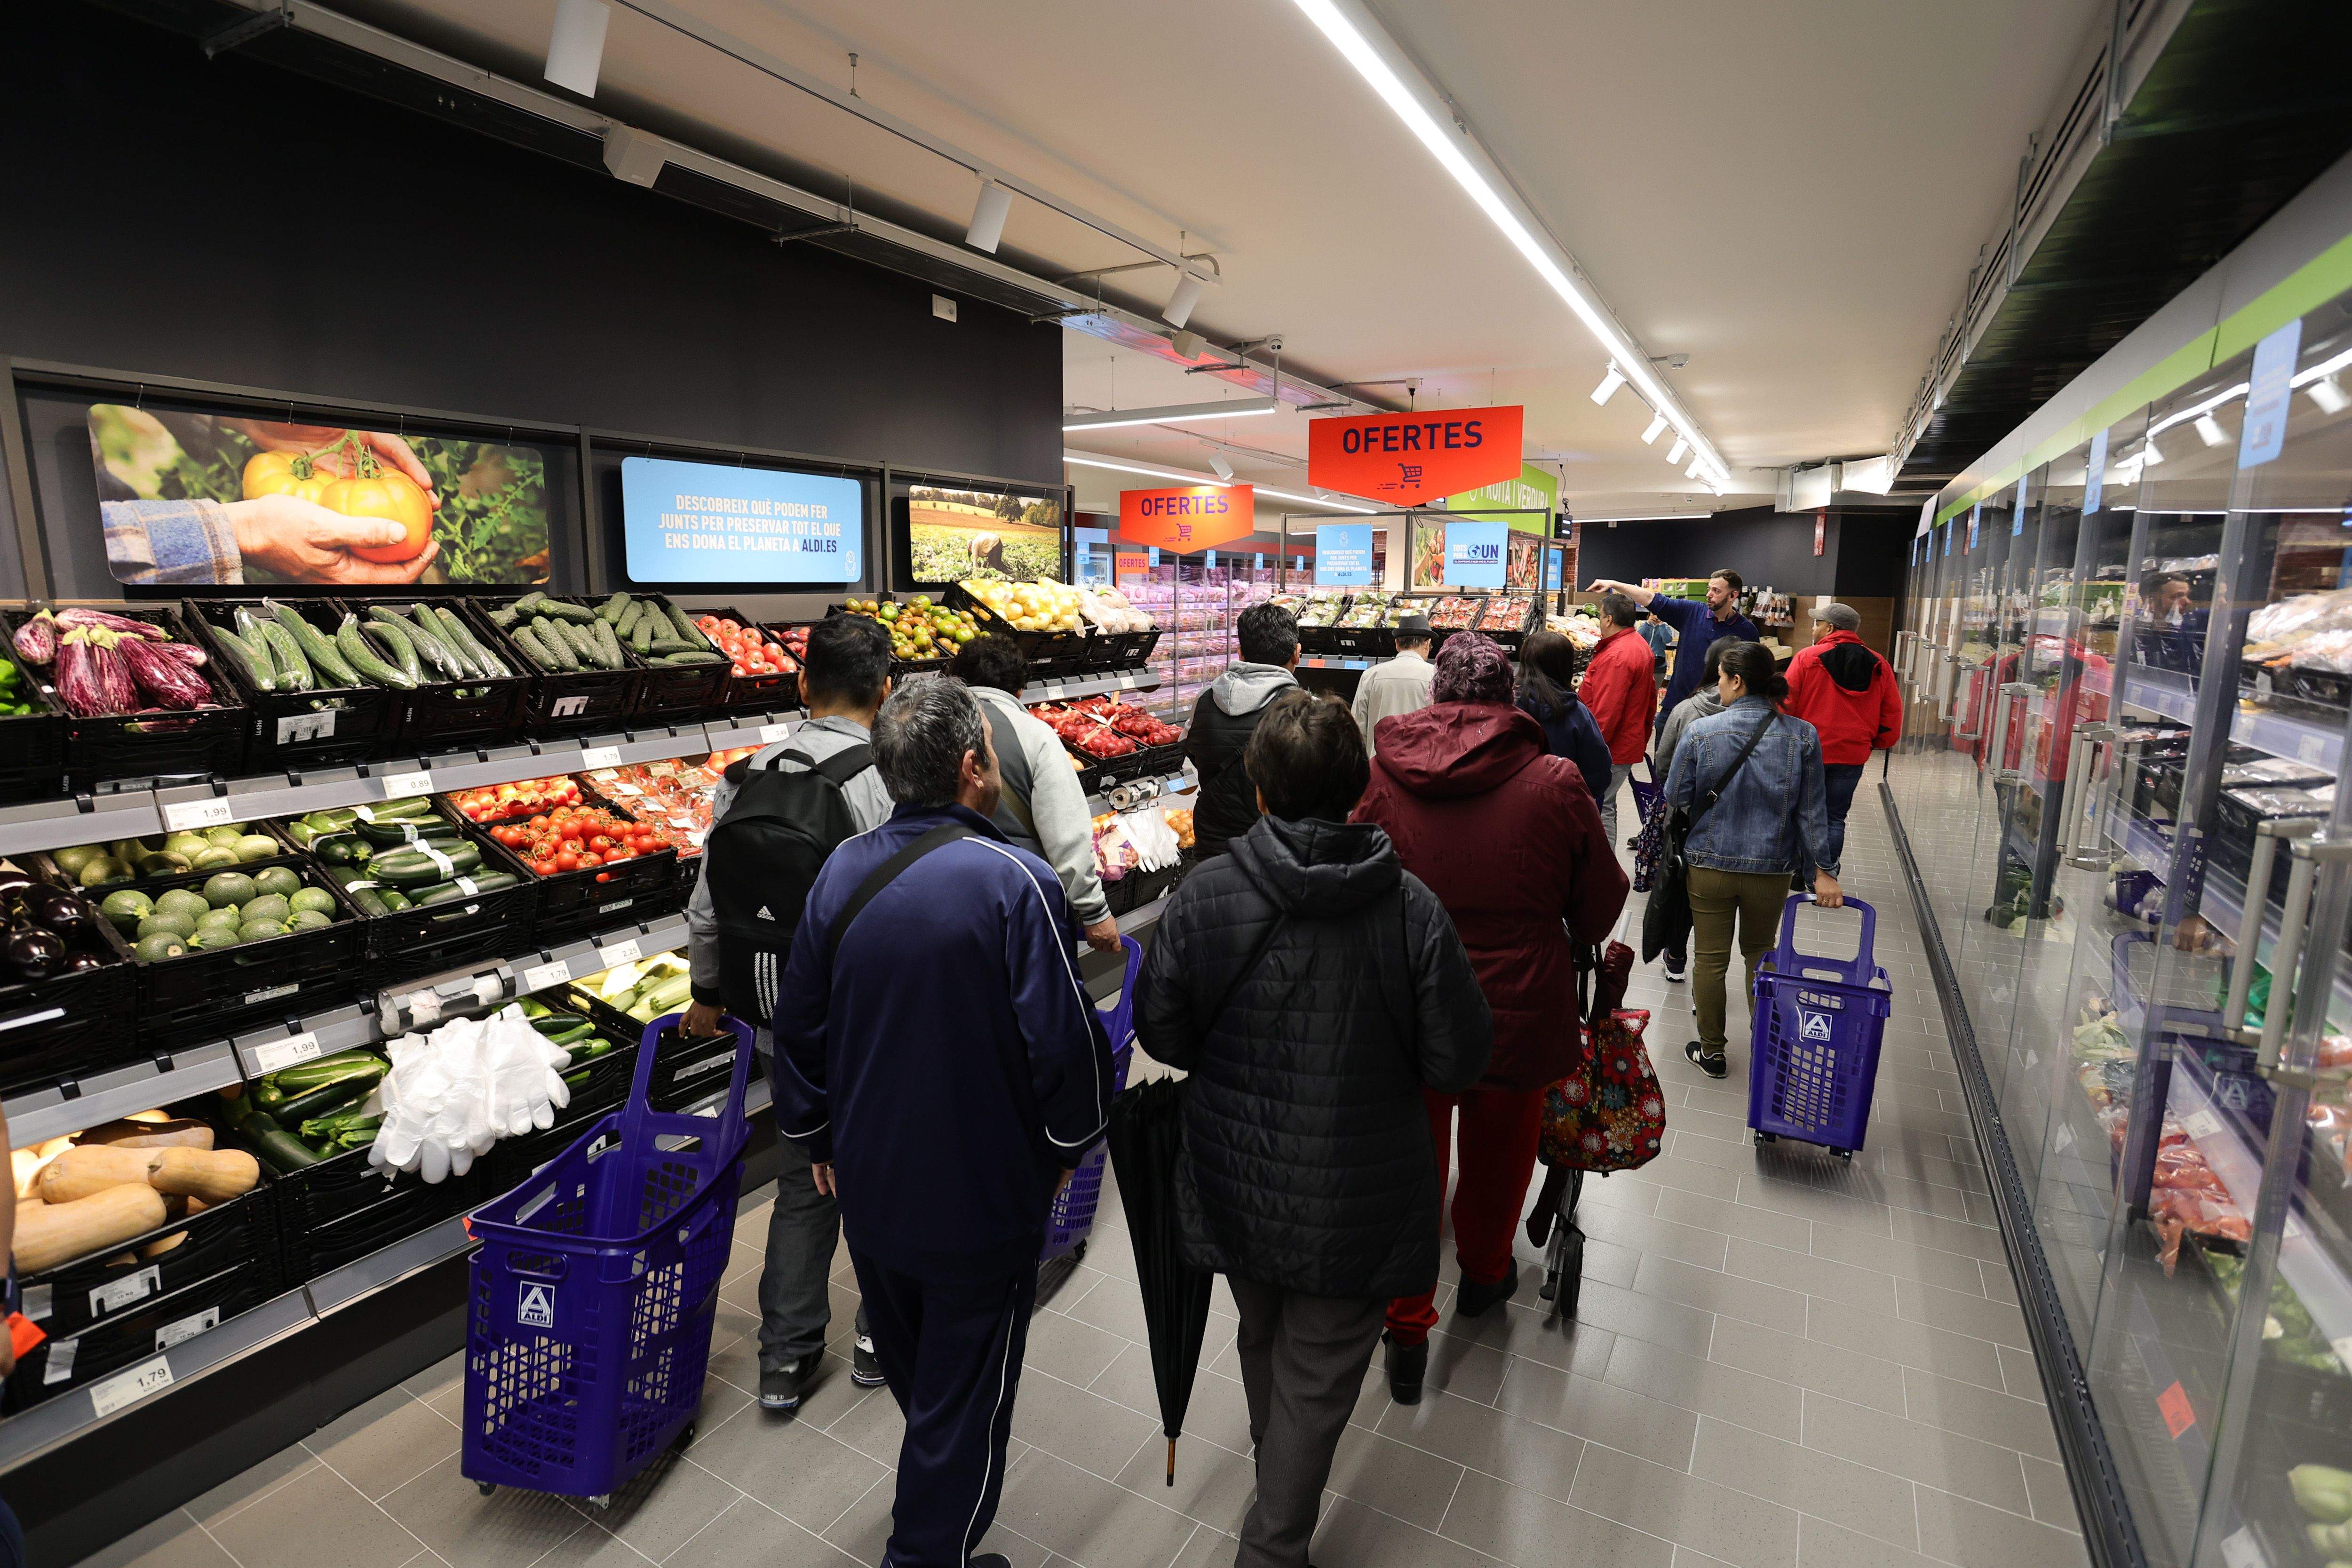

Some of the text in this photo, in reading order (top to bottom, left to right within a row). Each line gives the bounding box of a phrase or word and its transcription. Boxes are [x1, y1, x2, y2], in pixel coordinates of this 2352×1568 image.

[1343, 421, 1482, 454] OFERTES
[1141, 495, 1229, 516] OFERTES
[1518, 482, 1549, 515] VERDURA
[675, 494, 828, 519] DESCOBREIX QUÈ PODEM FER
[658, 513, 841, 537] JUNTS PER PRESERVAR TOT EL QUE
[665, 533, 837, 552] ENS DONA EL PLANETA A ALDI.ES
[1482, 544, 1498, 558] UN
[1119, 559, 1145, 567] OFERTES
[411, 780, 429, 788] 0,89
[204, 807, 226, 817] 1,99
[622, 947, 637, 956] 2,25
[550, 969, 566, 979] 1,79
[293, 1042, 315, 1054] 1,99
[524, 1313, 547, 1321] ALDI
[137, 1369, 165, 1387] 1,79
